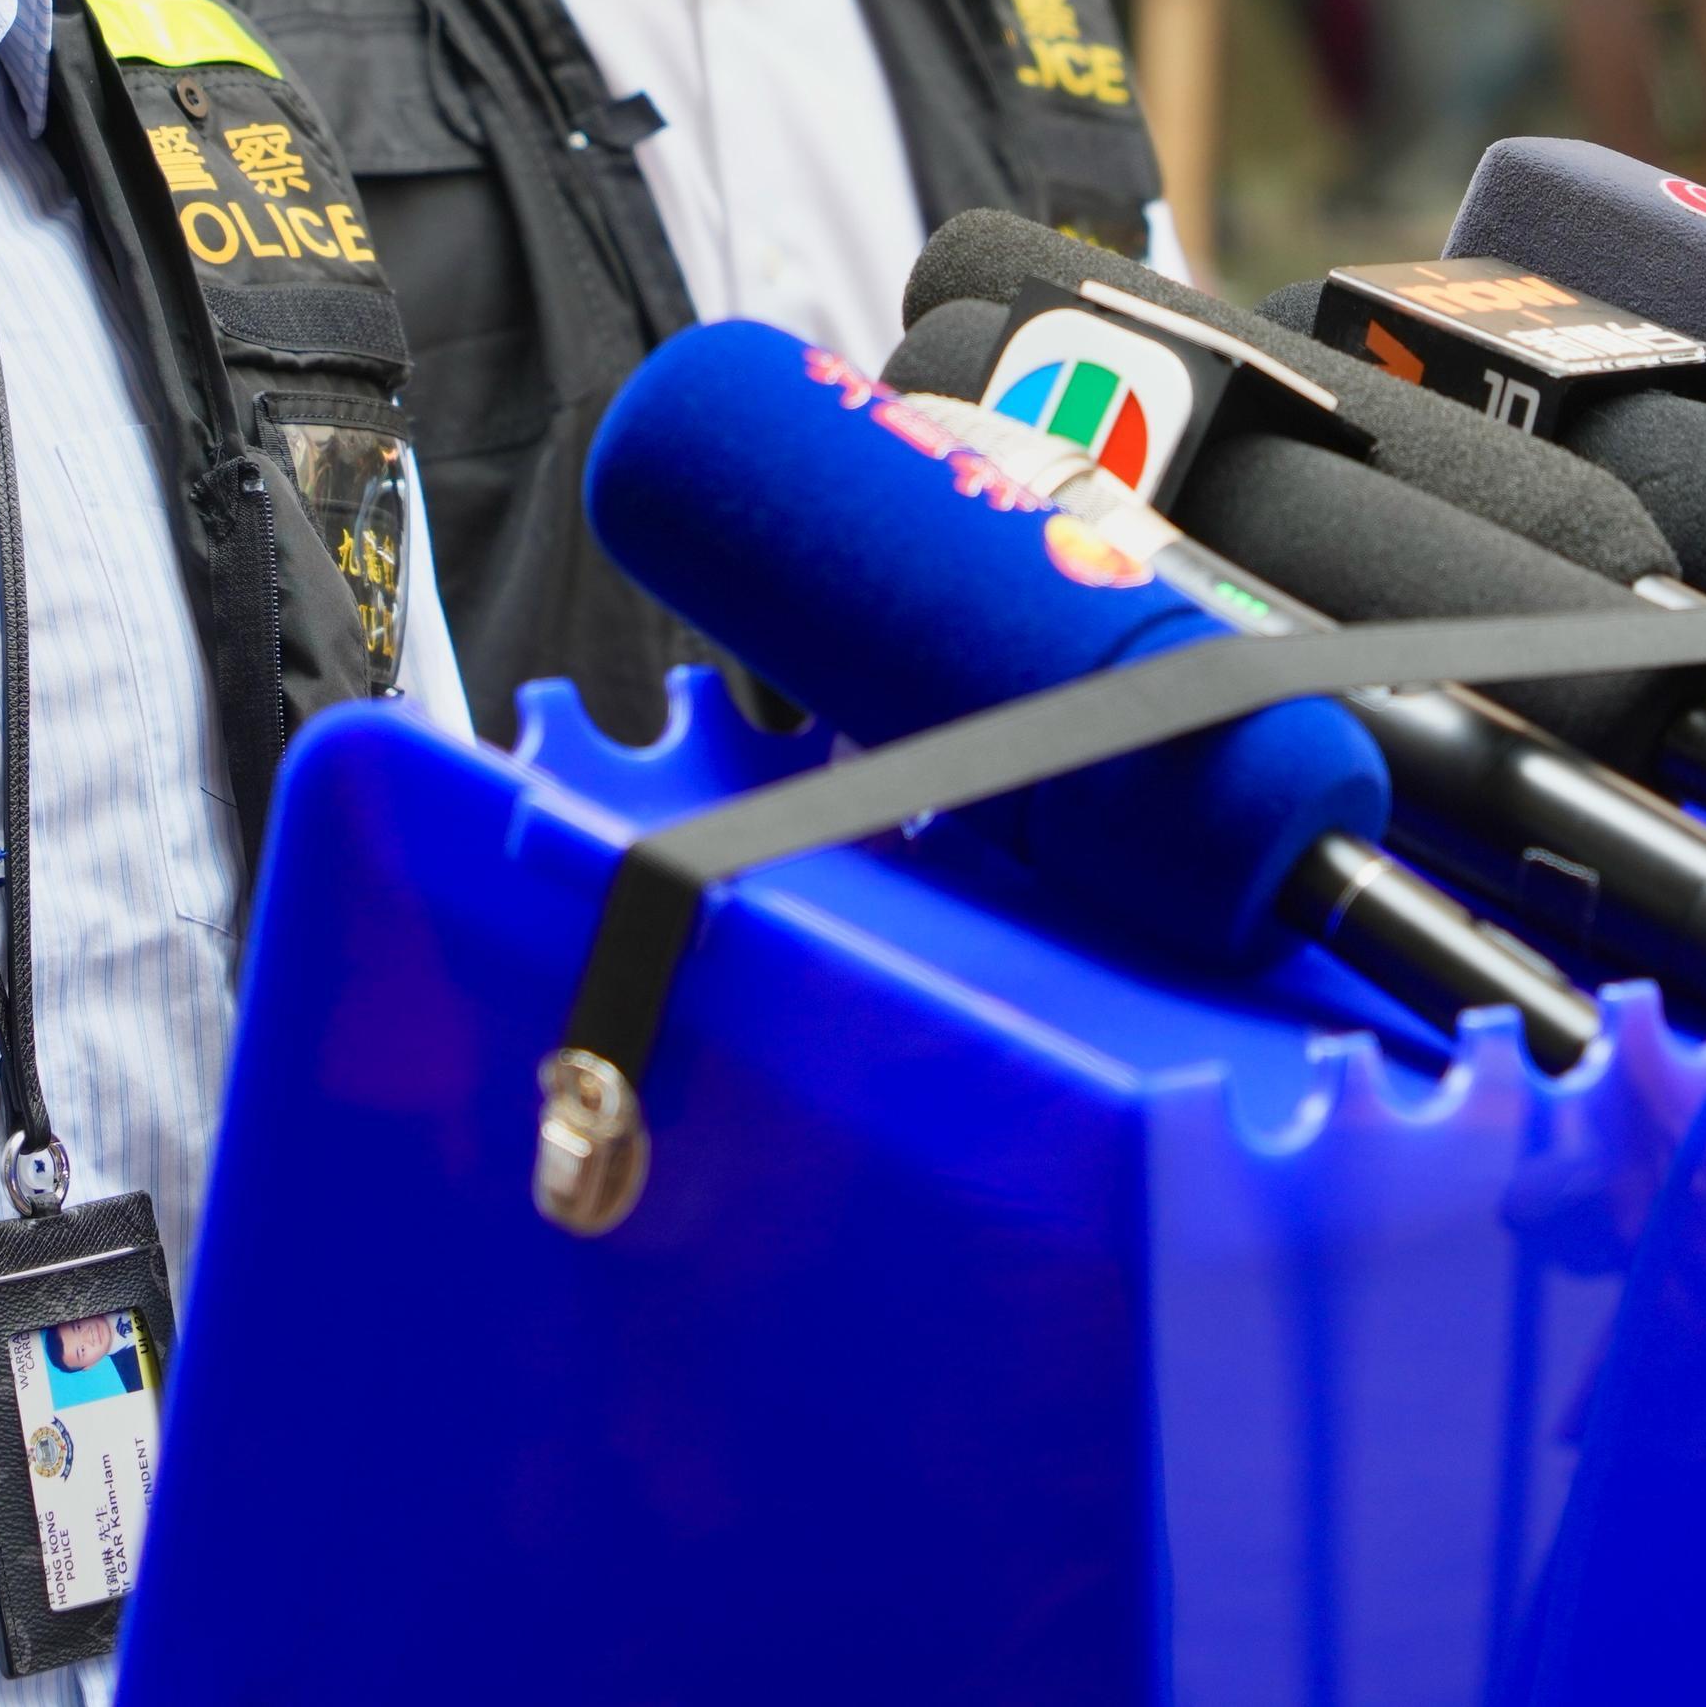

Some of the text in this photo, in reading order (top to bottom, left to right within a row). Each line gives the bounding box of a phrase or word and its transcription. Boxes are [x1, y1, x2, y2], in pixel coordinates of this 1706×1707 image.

[146, 122, 311, 198] 警察
[102, 1453, 121, 1529] Kam-lam
[45, 1510, 60, 1555] KONG
[96, 1504, 111, 1542] 先生
[59, 1529, 75, 1581] POLICE
[113, 1534, 128, 1574] GAR
[52, 1559, 67, 1606] HONG
